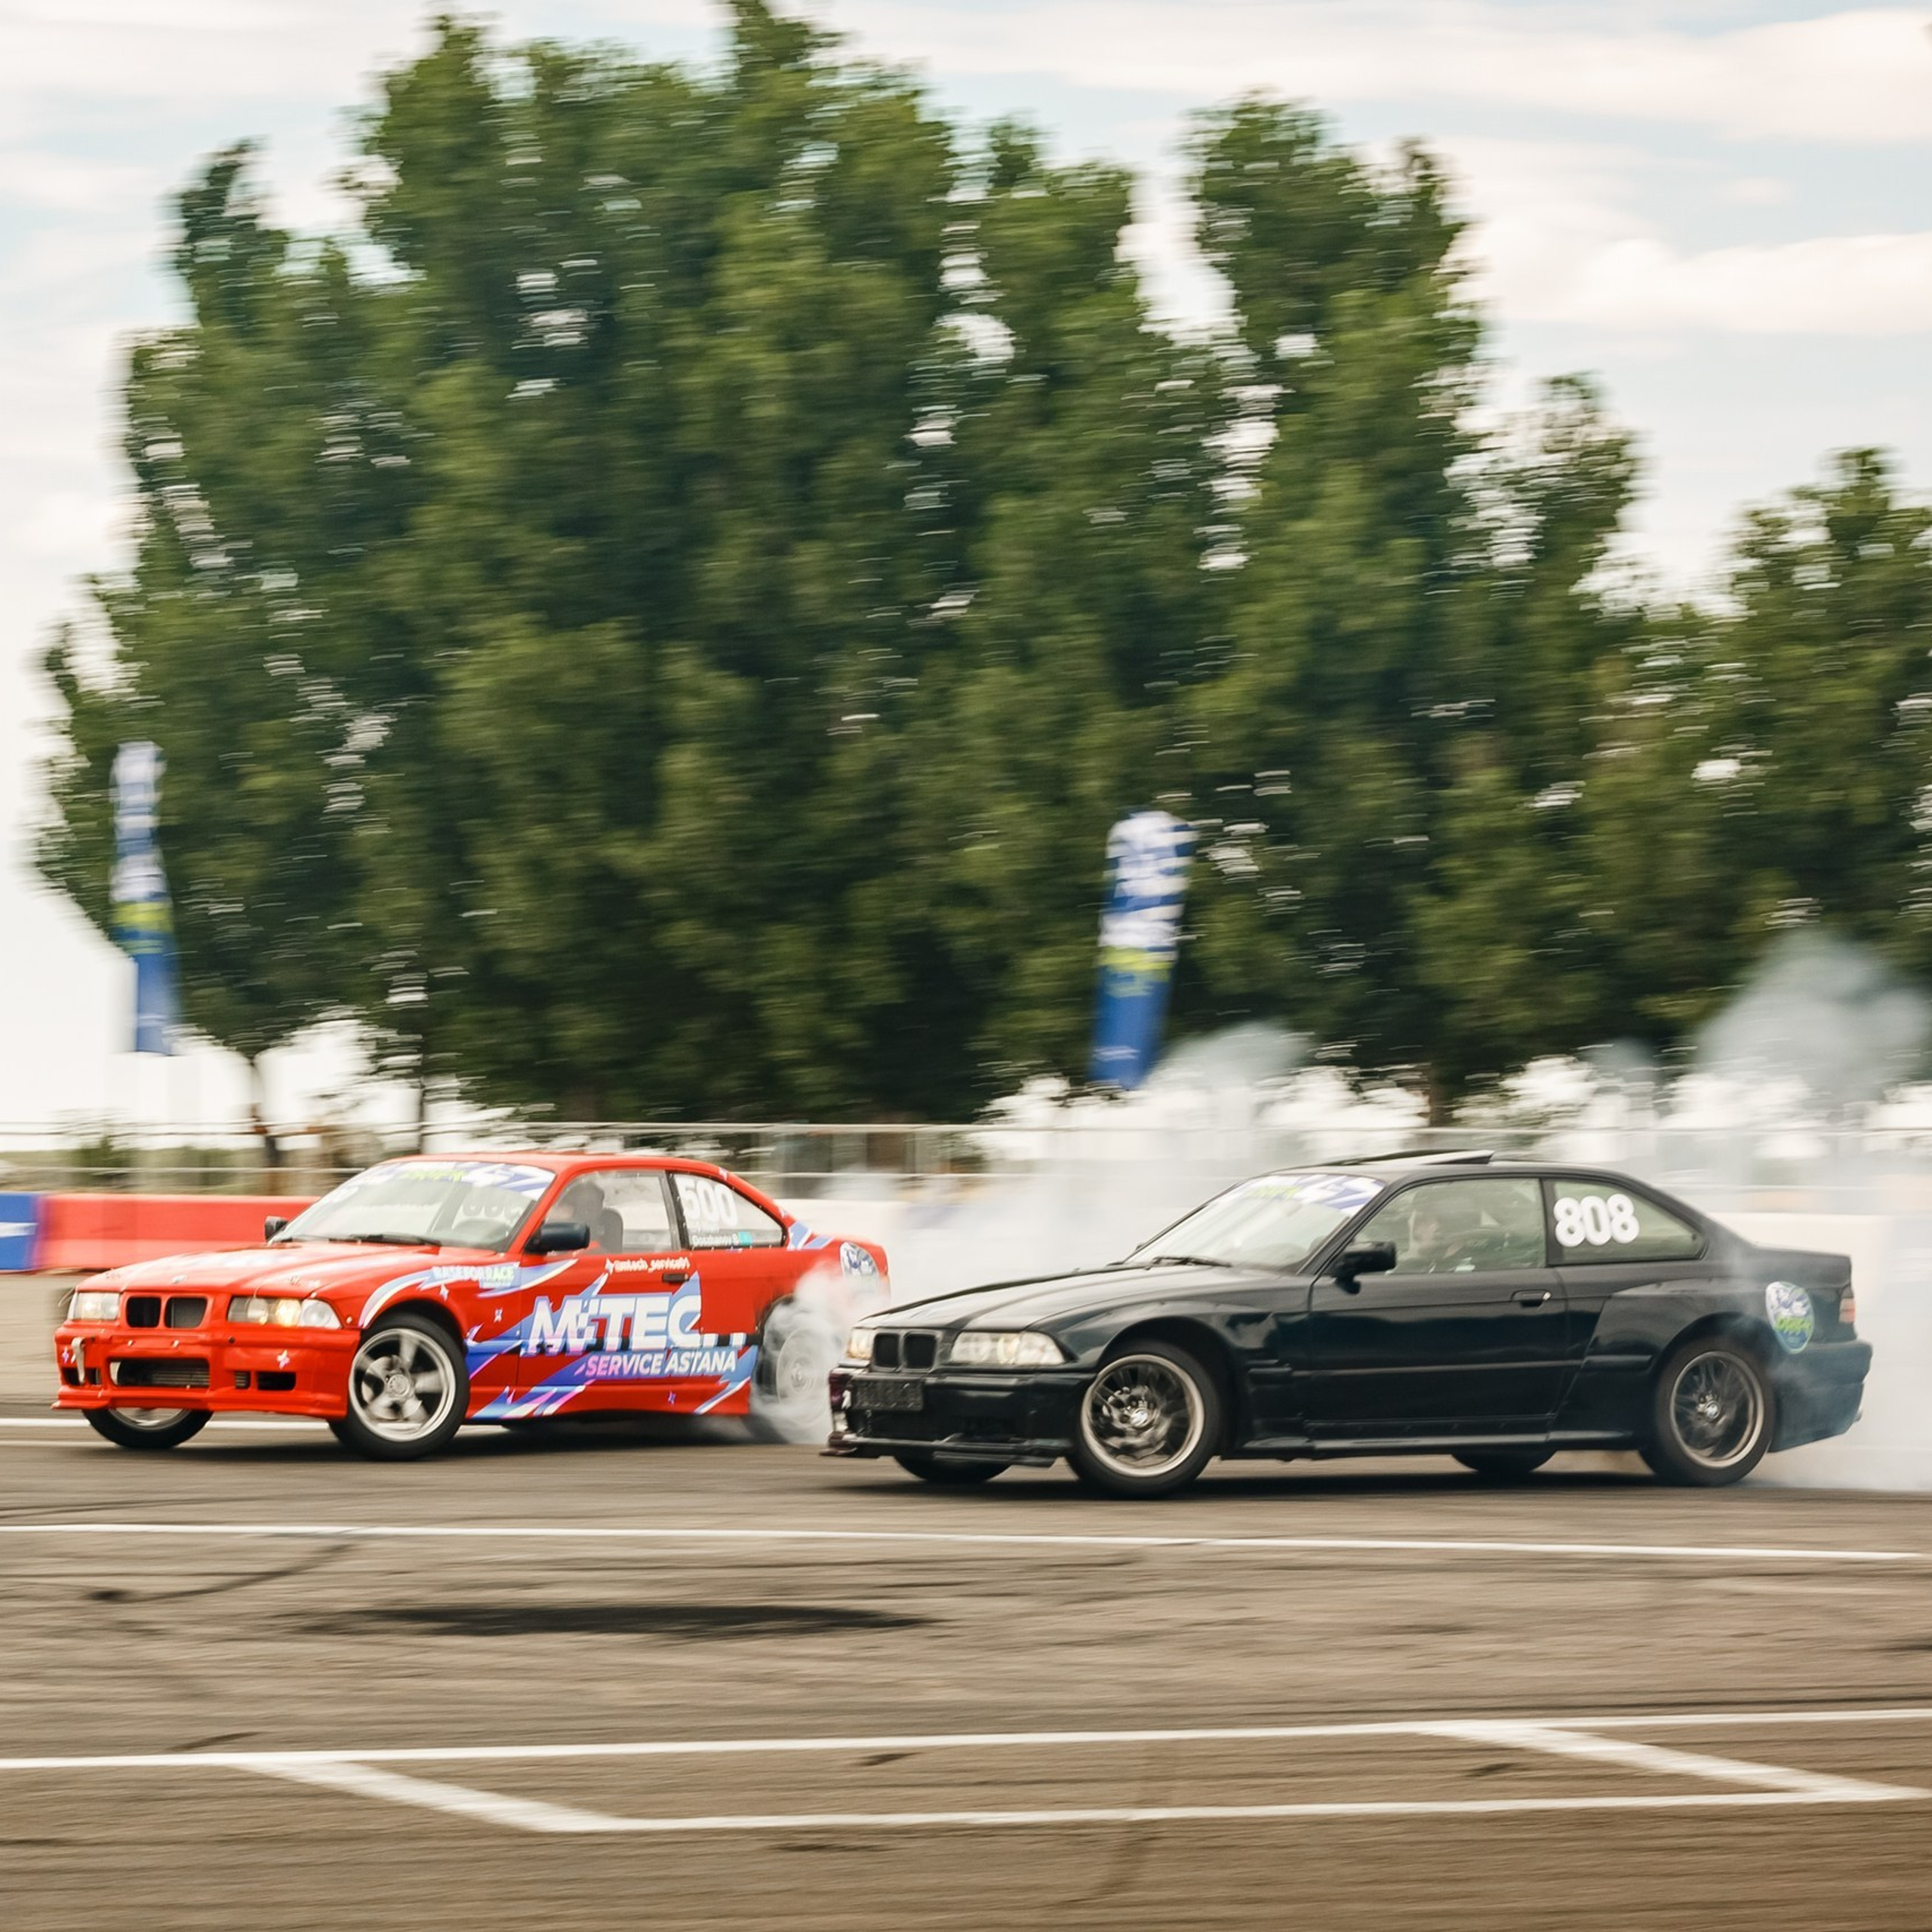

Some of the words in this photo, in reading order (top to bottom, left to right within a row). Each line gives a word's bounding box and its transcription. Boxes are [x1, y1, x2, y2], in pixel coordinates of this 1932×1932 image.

[675, 1176, 738, 1226] 500
[1554, 1194, 1639, 1247] 808
[585, 1353, 662, 1376] SERVICE
[664, 1350, 736, 1375] ASTANA
